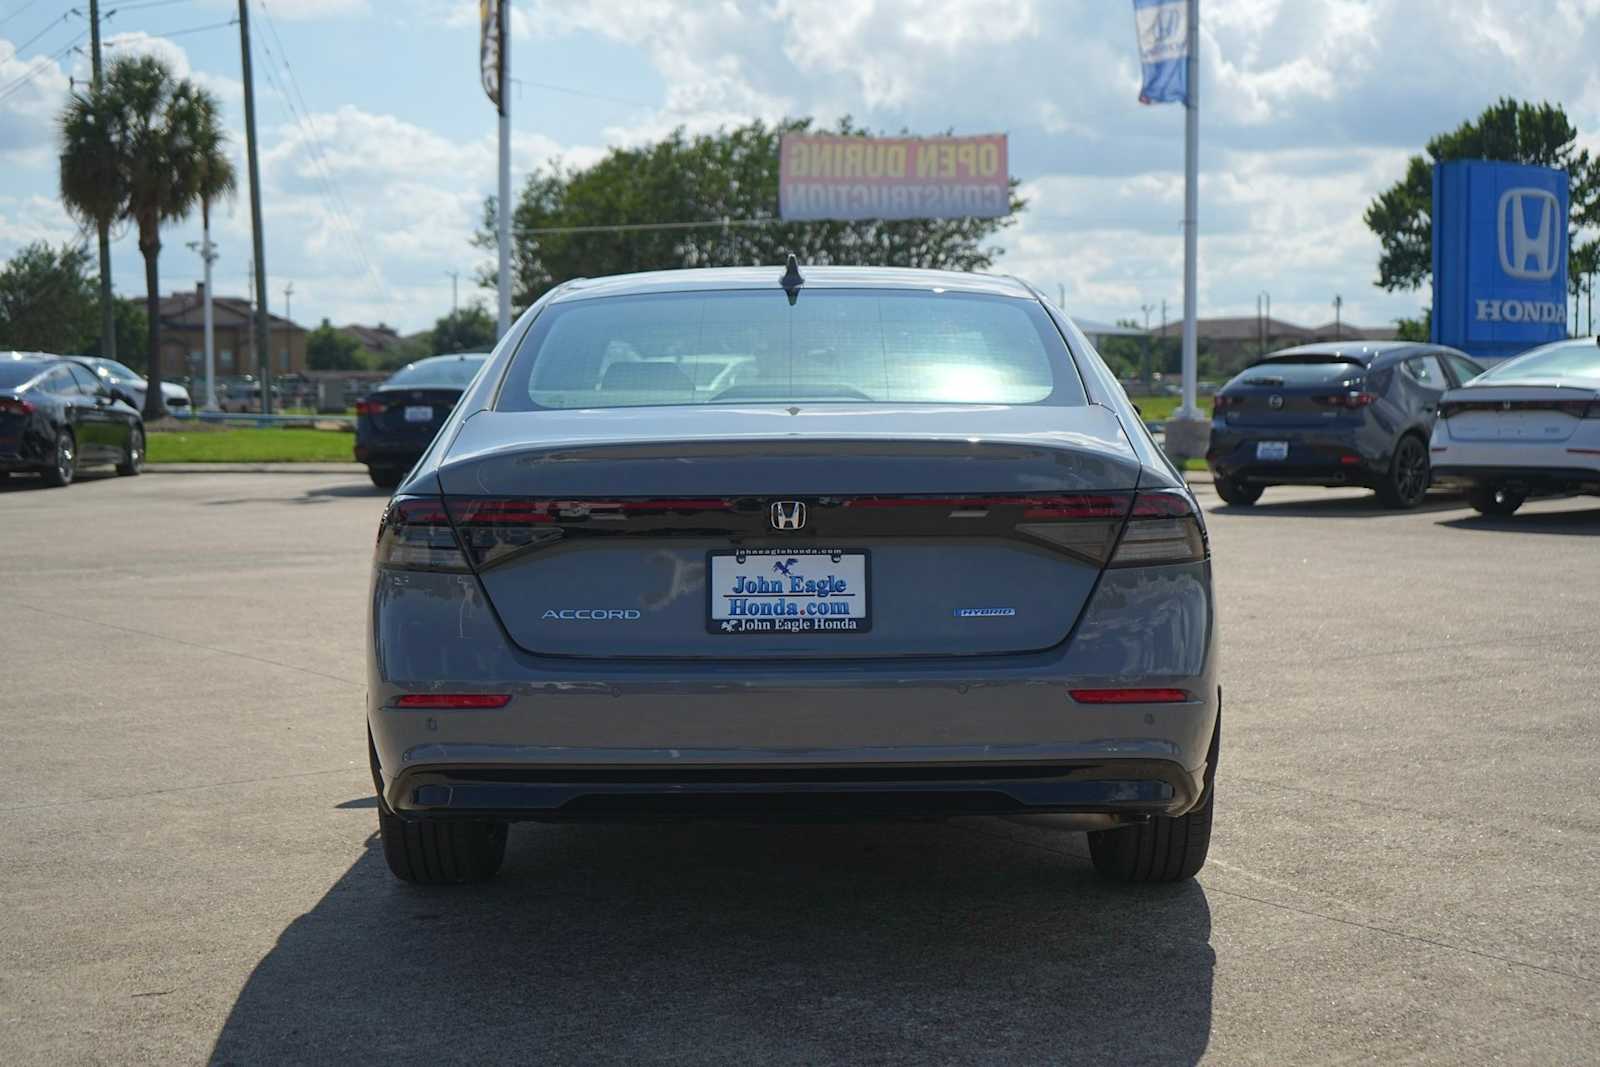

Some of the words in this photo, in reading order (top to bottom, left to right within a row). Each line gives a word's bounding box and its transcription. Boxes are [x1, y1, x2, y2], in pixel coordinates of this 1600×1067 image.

[1475, 299, 1566, 324] HONDA
[732, 576, 783, 594] John
[789, 575, 847, 597] Eagle
[541, 609, 641, 620] ACCORD
[728, 598, 850, 616] Honda.com
[960, 608, 1016, 617] HYBRID
[738, 618, 771, 632] John
[774, 618, 811, 633] Eagle
[814, 618, 857, 631] Honda
